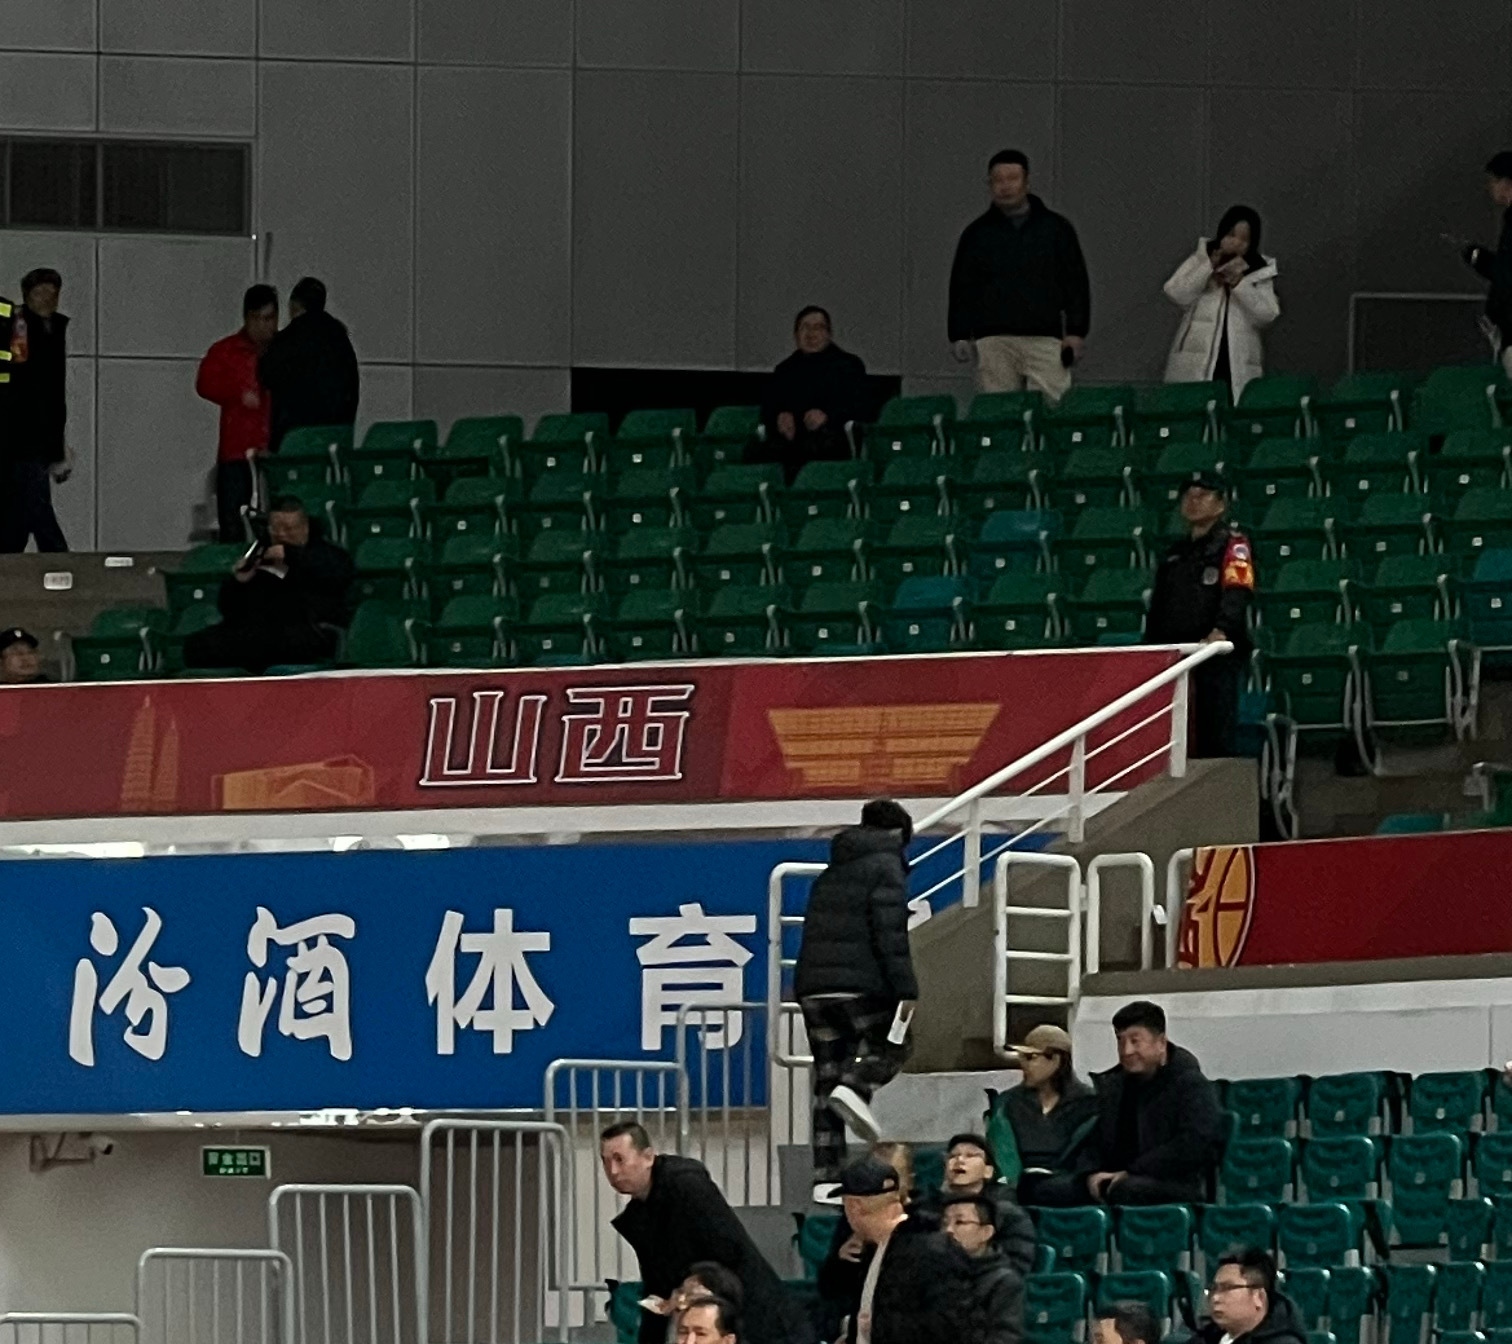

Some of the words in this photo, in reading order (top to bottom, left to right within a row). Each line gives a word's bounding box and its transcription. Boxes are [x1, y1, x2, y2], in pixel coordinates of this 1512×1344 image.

[418, 684, 695, 787] 山西
[68, 899, 931, 1067] 汾酒体育
